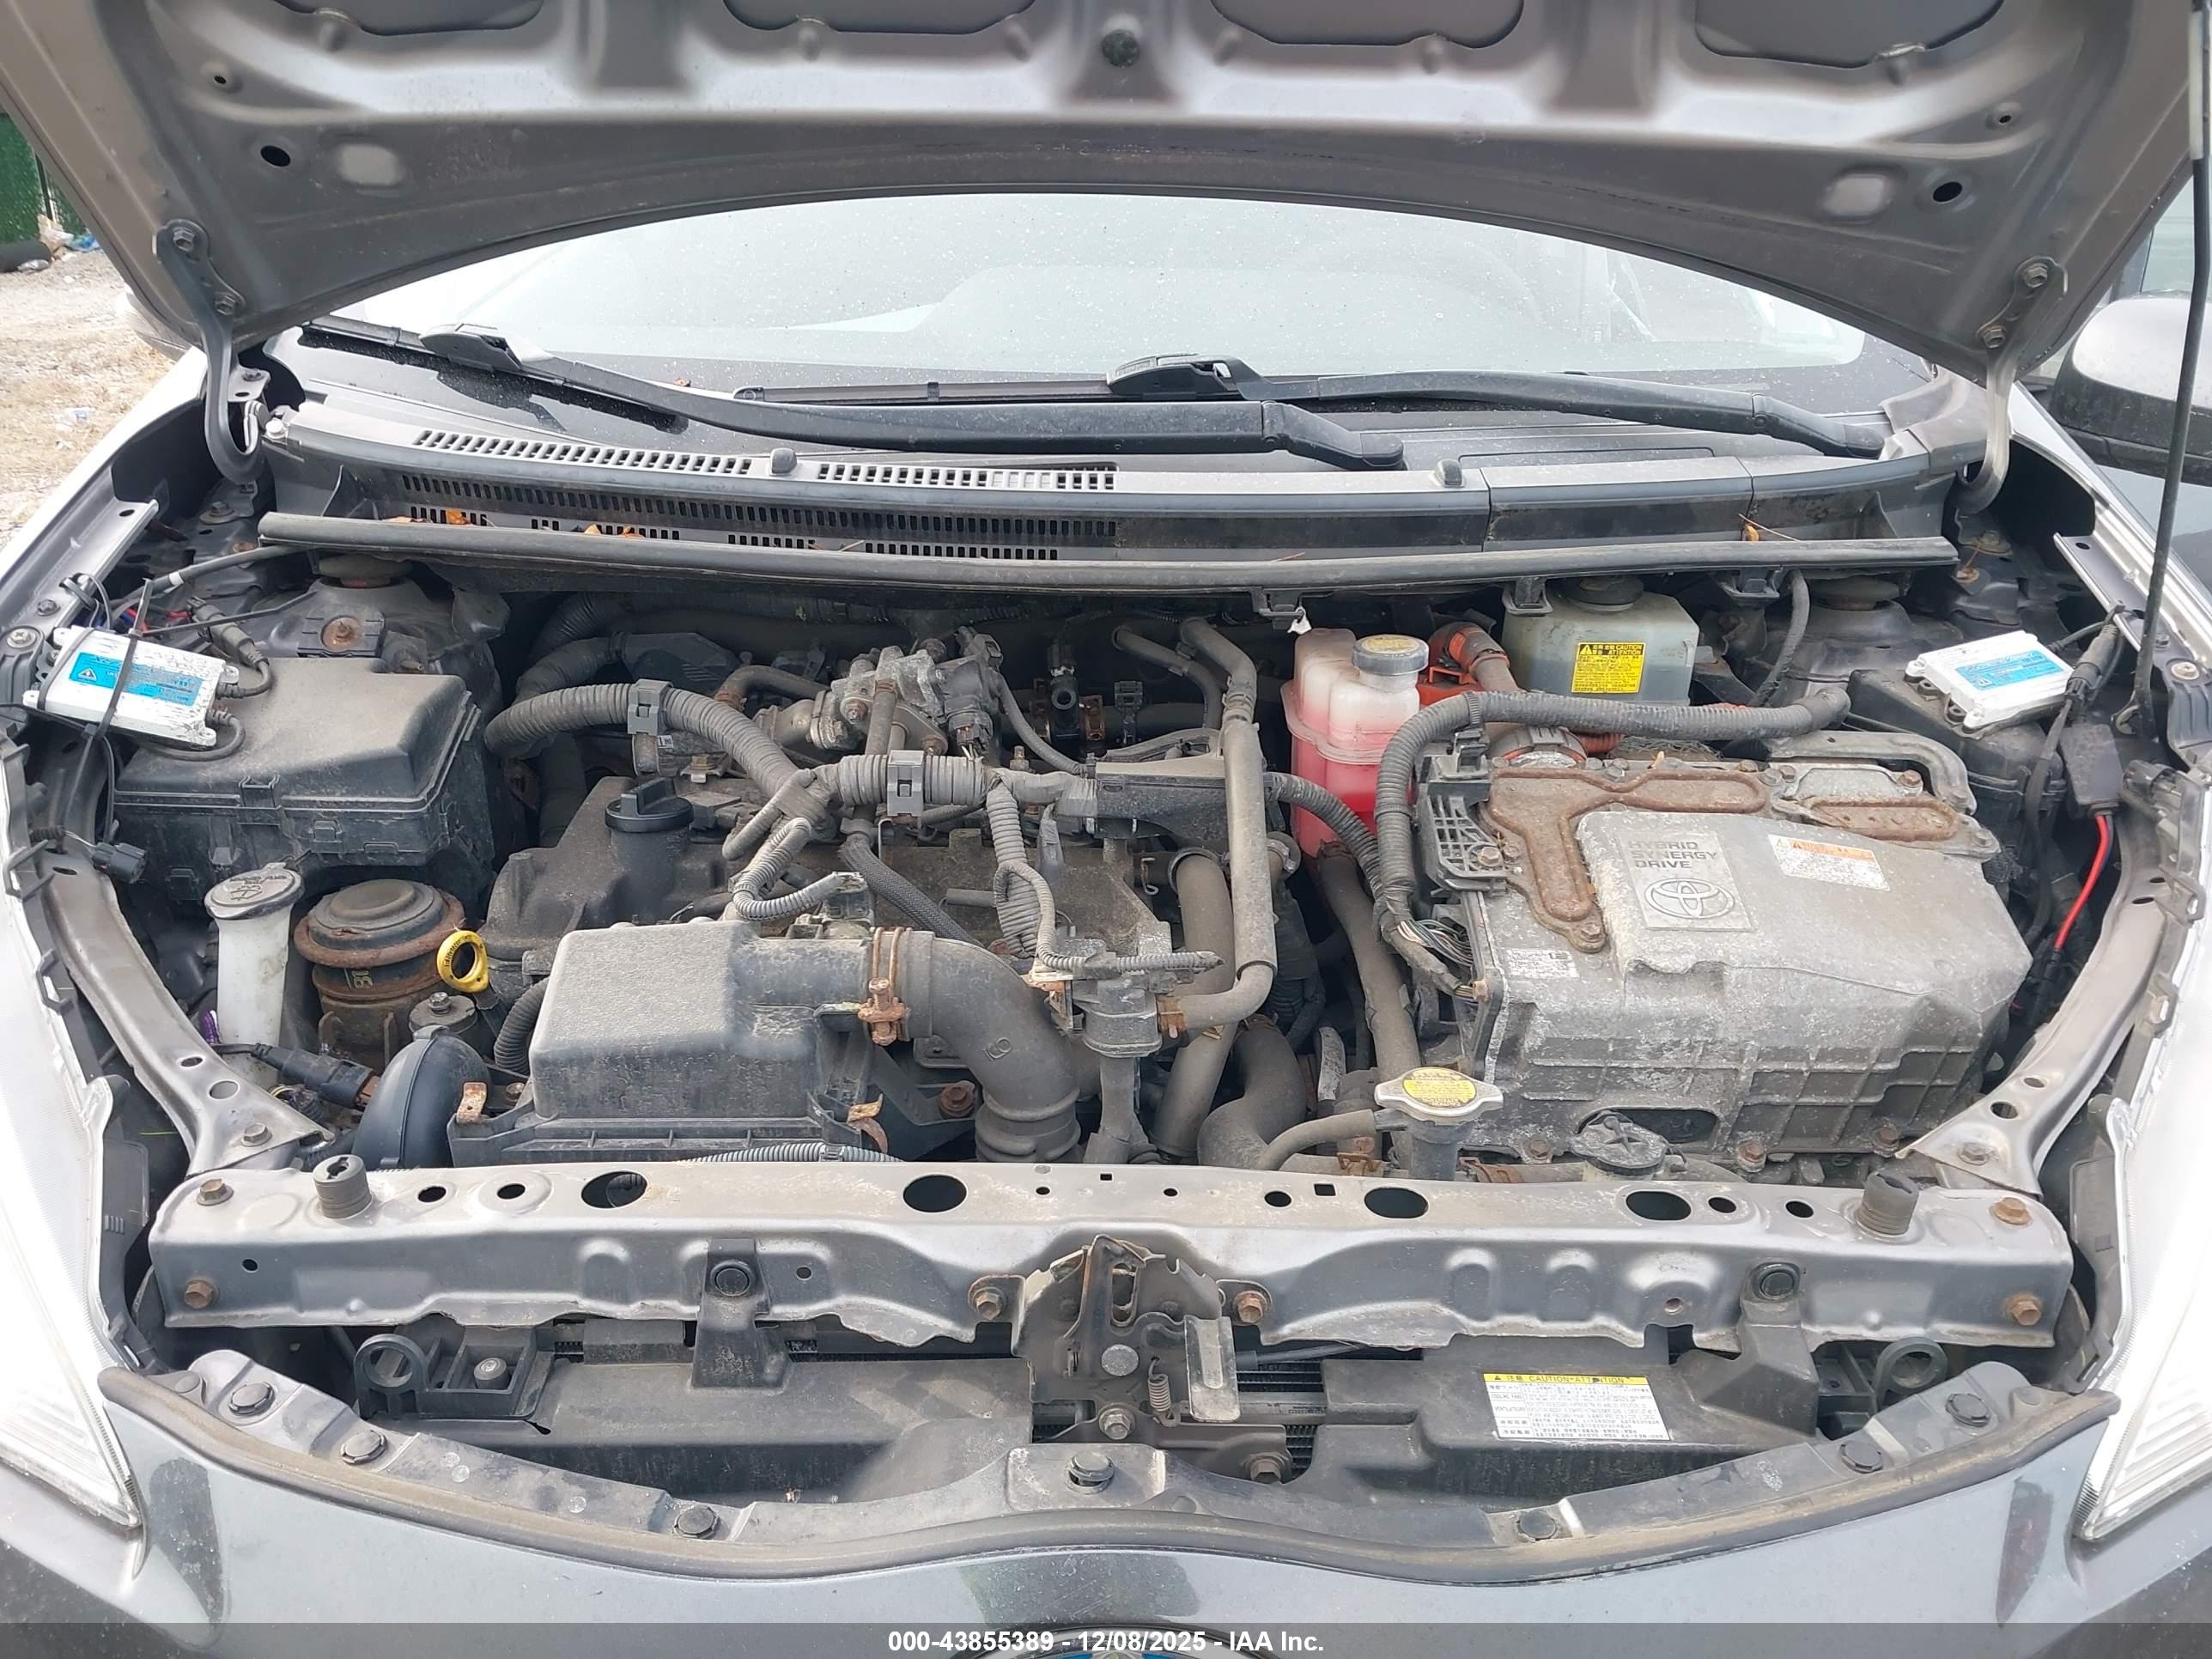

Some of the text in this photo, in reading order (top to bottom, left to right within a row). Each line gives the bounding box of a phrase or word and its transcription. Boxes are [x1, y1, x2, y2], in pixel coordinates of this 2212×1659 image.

[1629, 841, 1698, 850] HYBRID
[1632, 851, 1717, 860] SYNERGY
[1634, 860, 1692, 868] DRIVE
